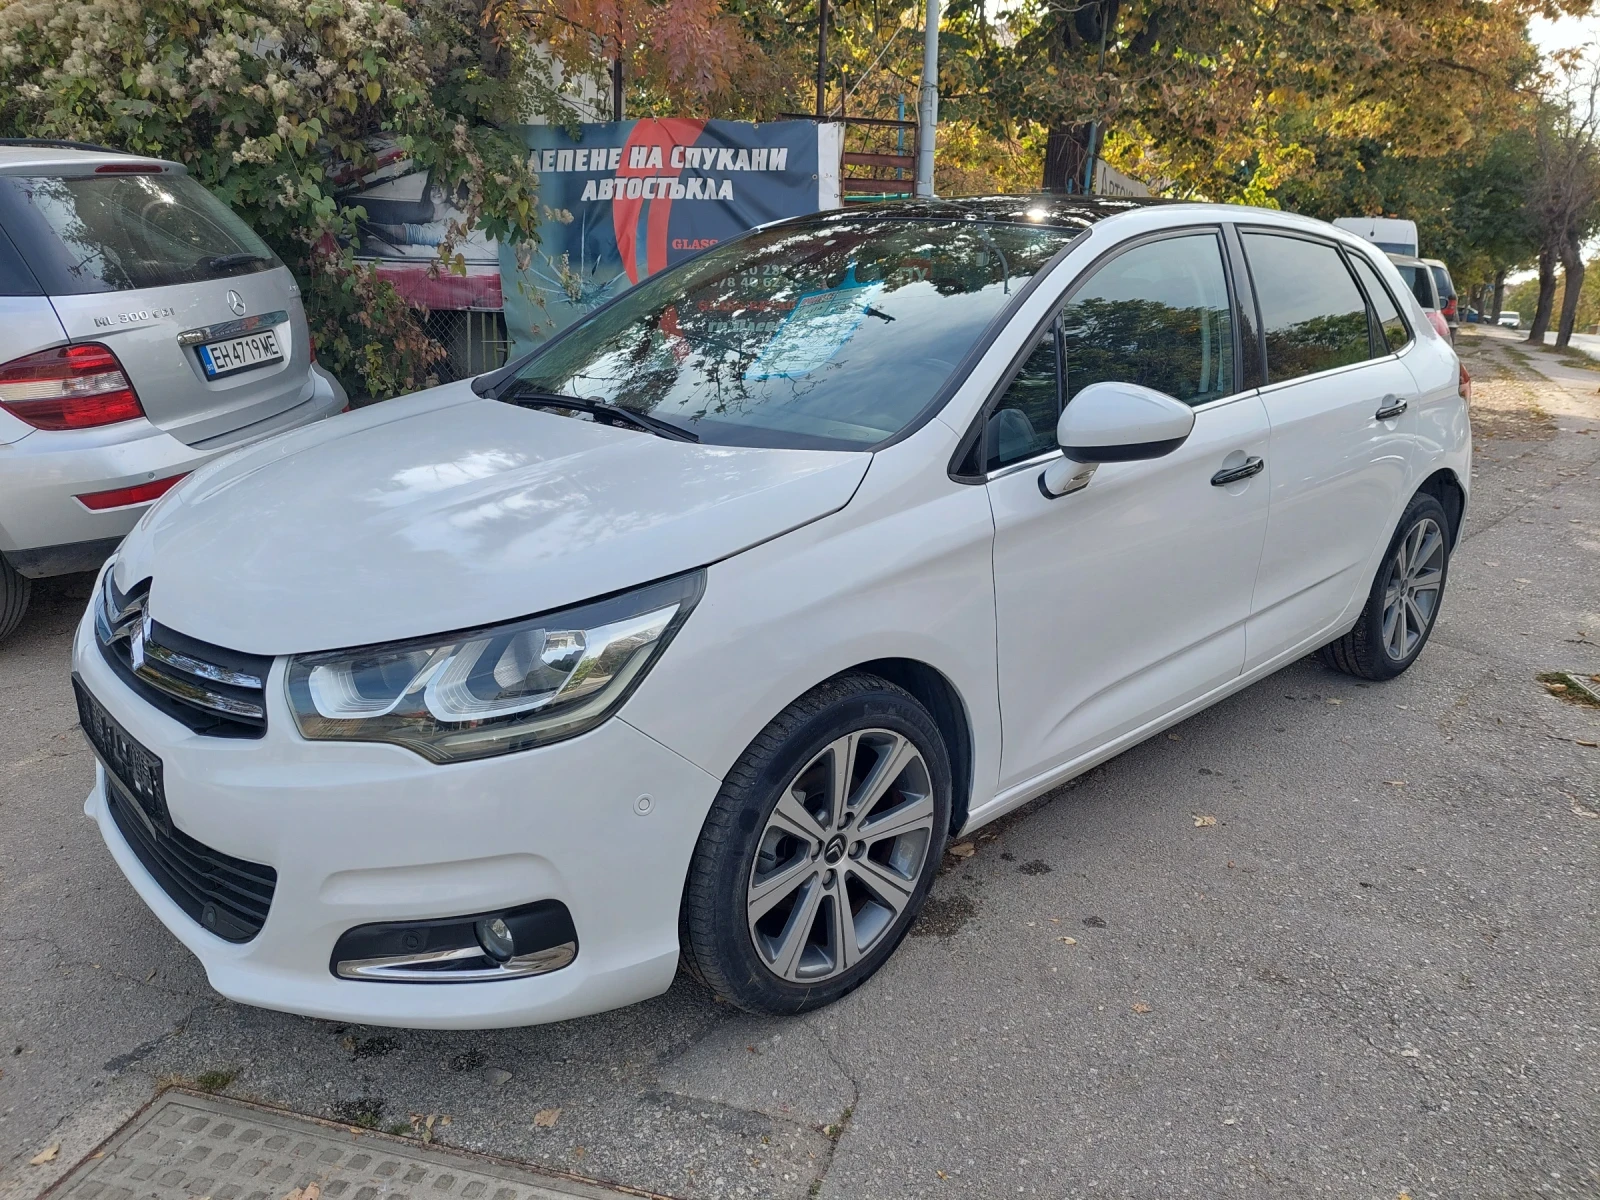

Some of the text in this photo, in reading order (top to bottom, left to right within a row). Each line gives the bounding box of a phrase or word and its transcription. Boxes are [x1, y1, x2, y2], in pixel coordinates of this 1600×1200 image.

[628, 146, 664, 169] НА
[670, 146, 788, 171] СПУКАНИ
[580, 177, 734, 202] АВТОСТЪКЛА
[94, 315, 116, 327] ML
[118, 310, 149, 324] 300
